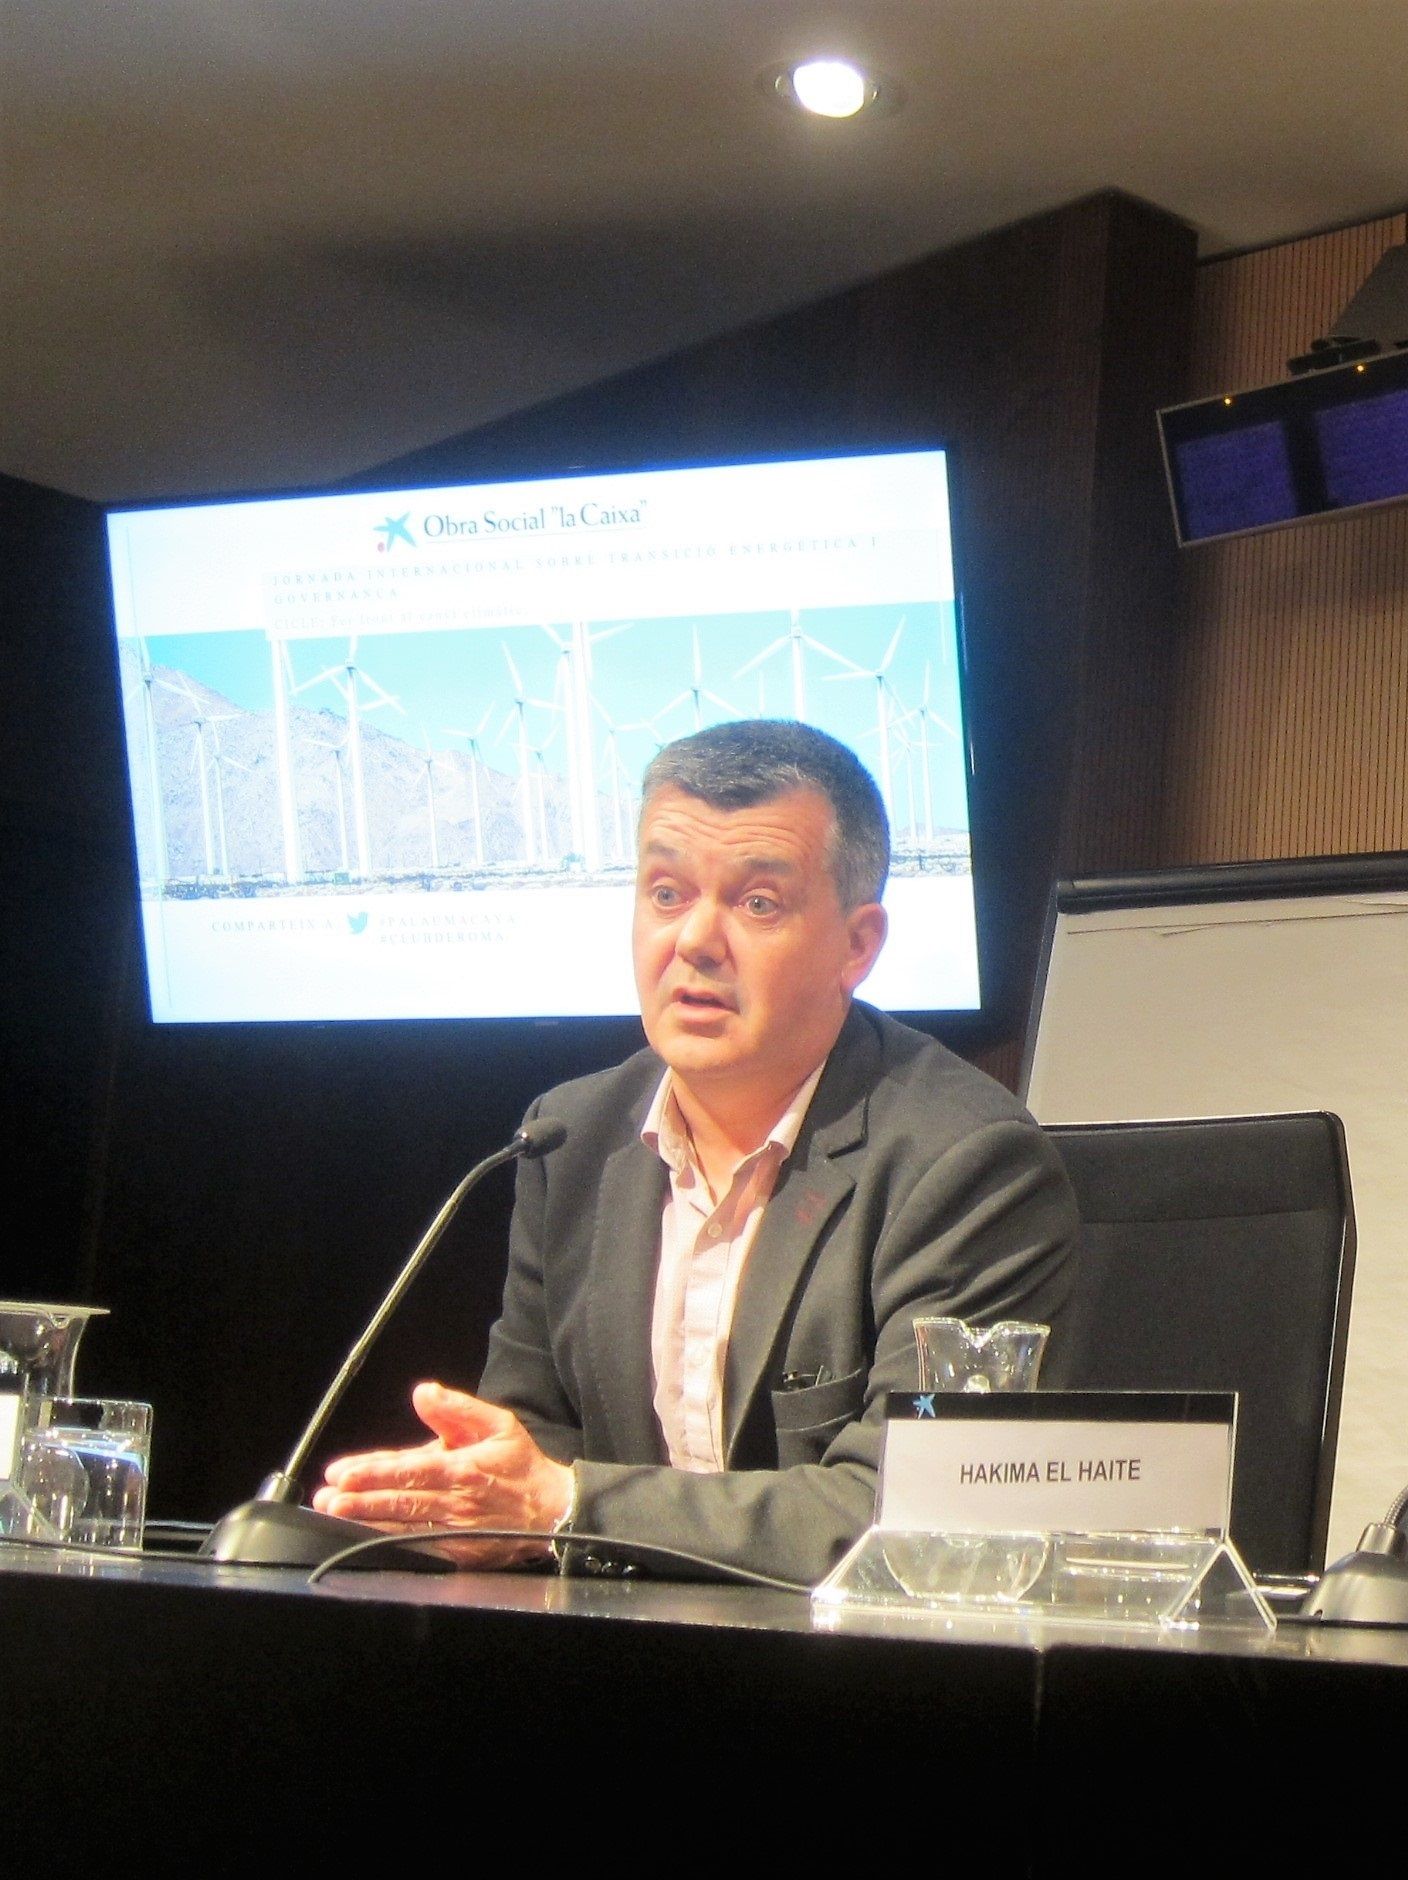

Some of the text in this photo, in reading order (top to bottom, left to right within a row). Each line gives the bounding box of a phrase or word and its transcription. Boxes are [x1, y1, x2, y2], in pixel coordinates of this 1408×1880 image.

[423, 514, 478, 537] Obra
[483, 507, 546, 533] Social
[366, 557, 522, 582] INTERNACIONAL
[959, 1458, 1142, 1485] HAKIMA EL HAITE
